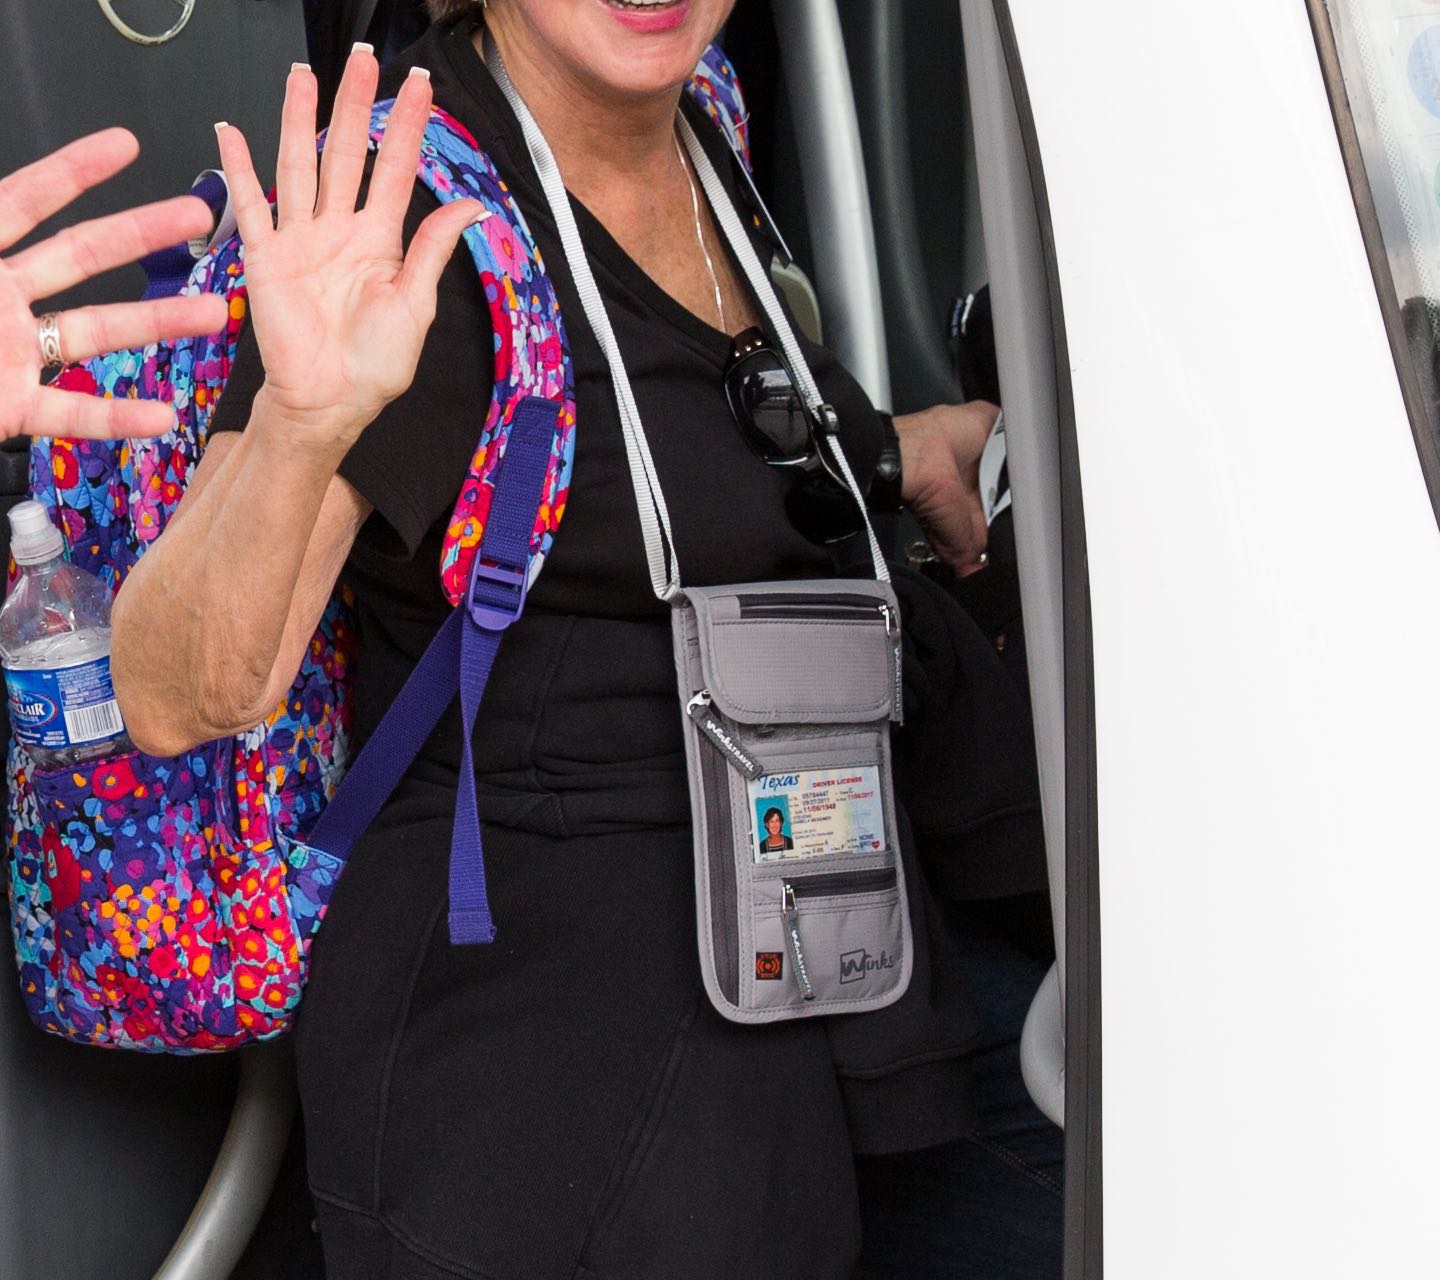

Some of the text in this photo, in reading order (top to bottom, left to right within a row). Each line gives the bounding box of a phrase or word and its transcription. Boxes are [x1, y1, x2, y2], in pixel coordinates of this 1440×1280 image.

[759, 774, 800, 791] Texas
[812, 776, 863, 788] DRIVER LICENSE
[840, 950, 894, 980] Winks
